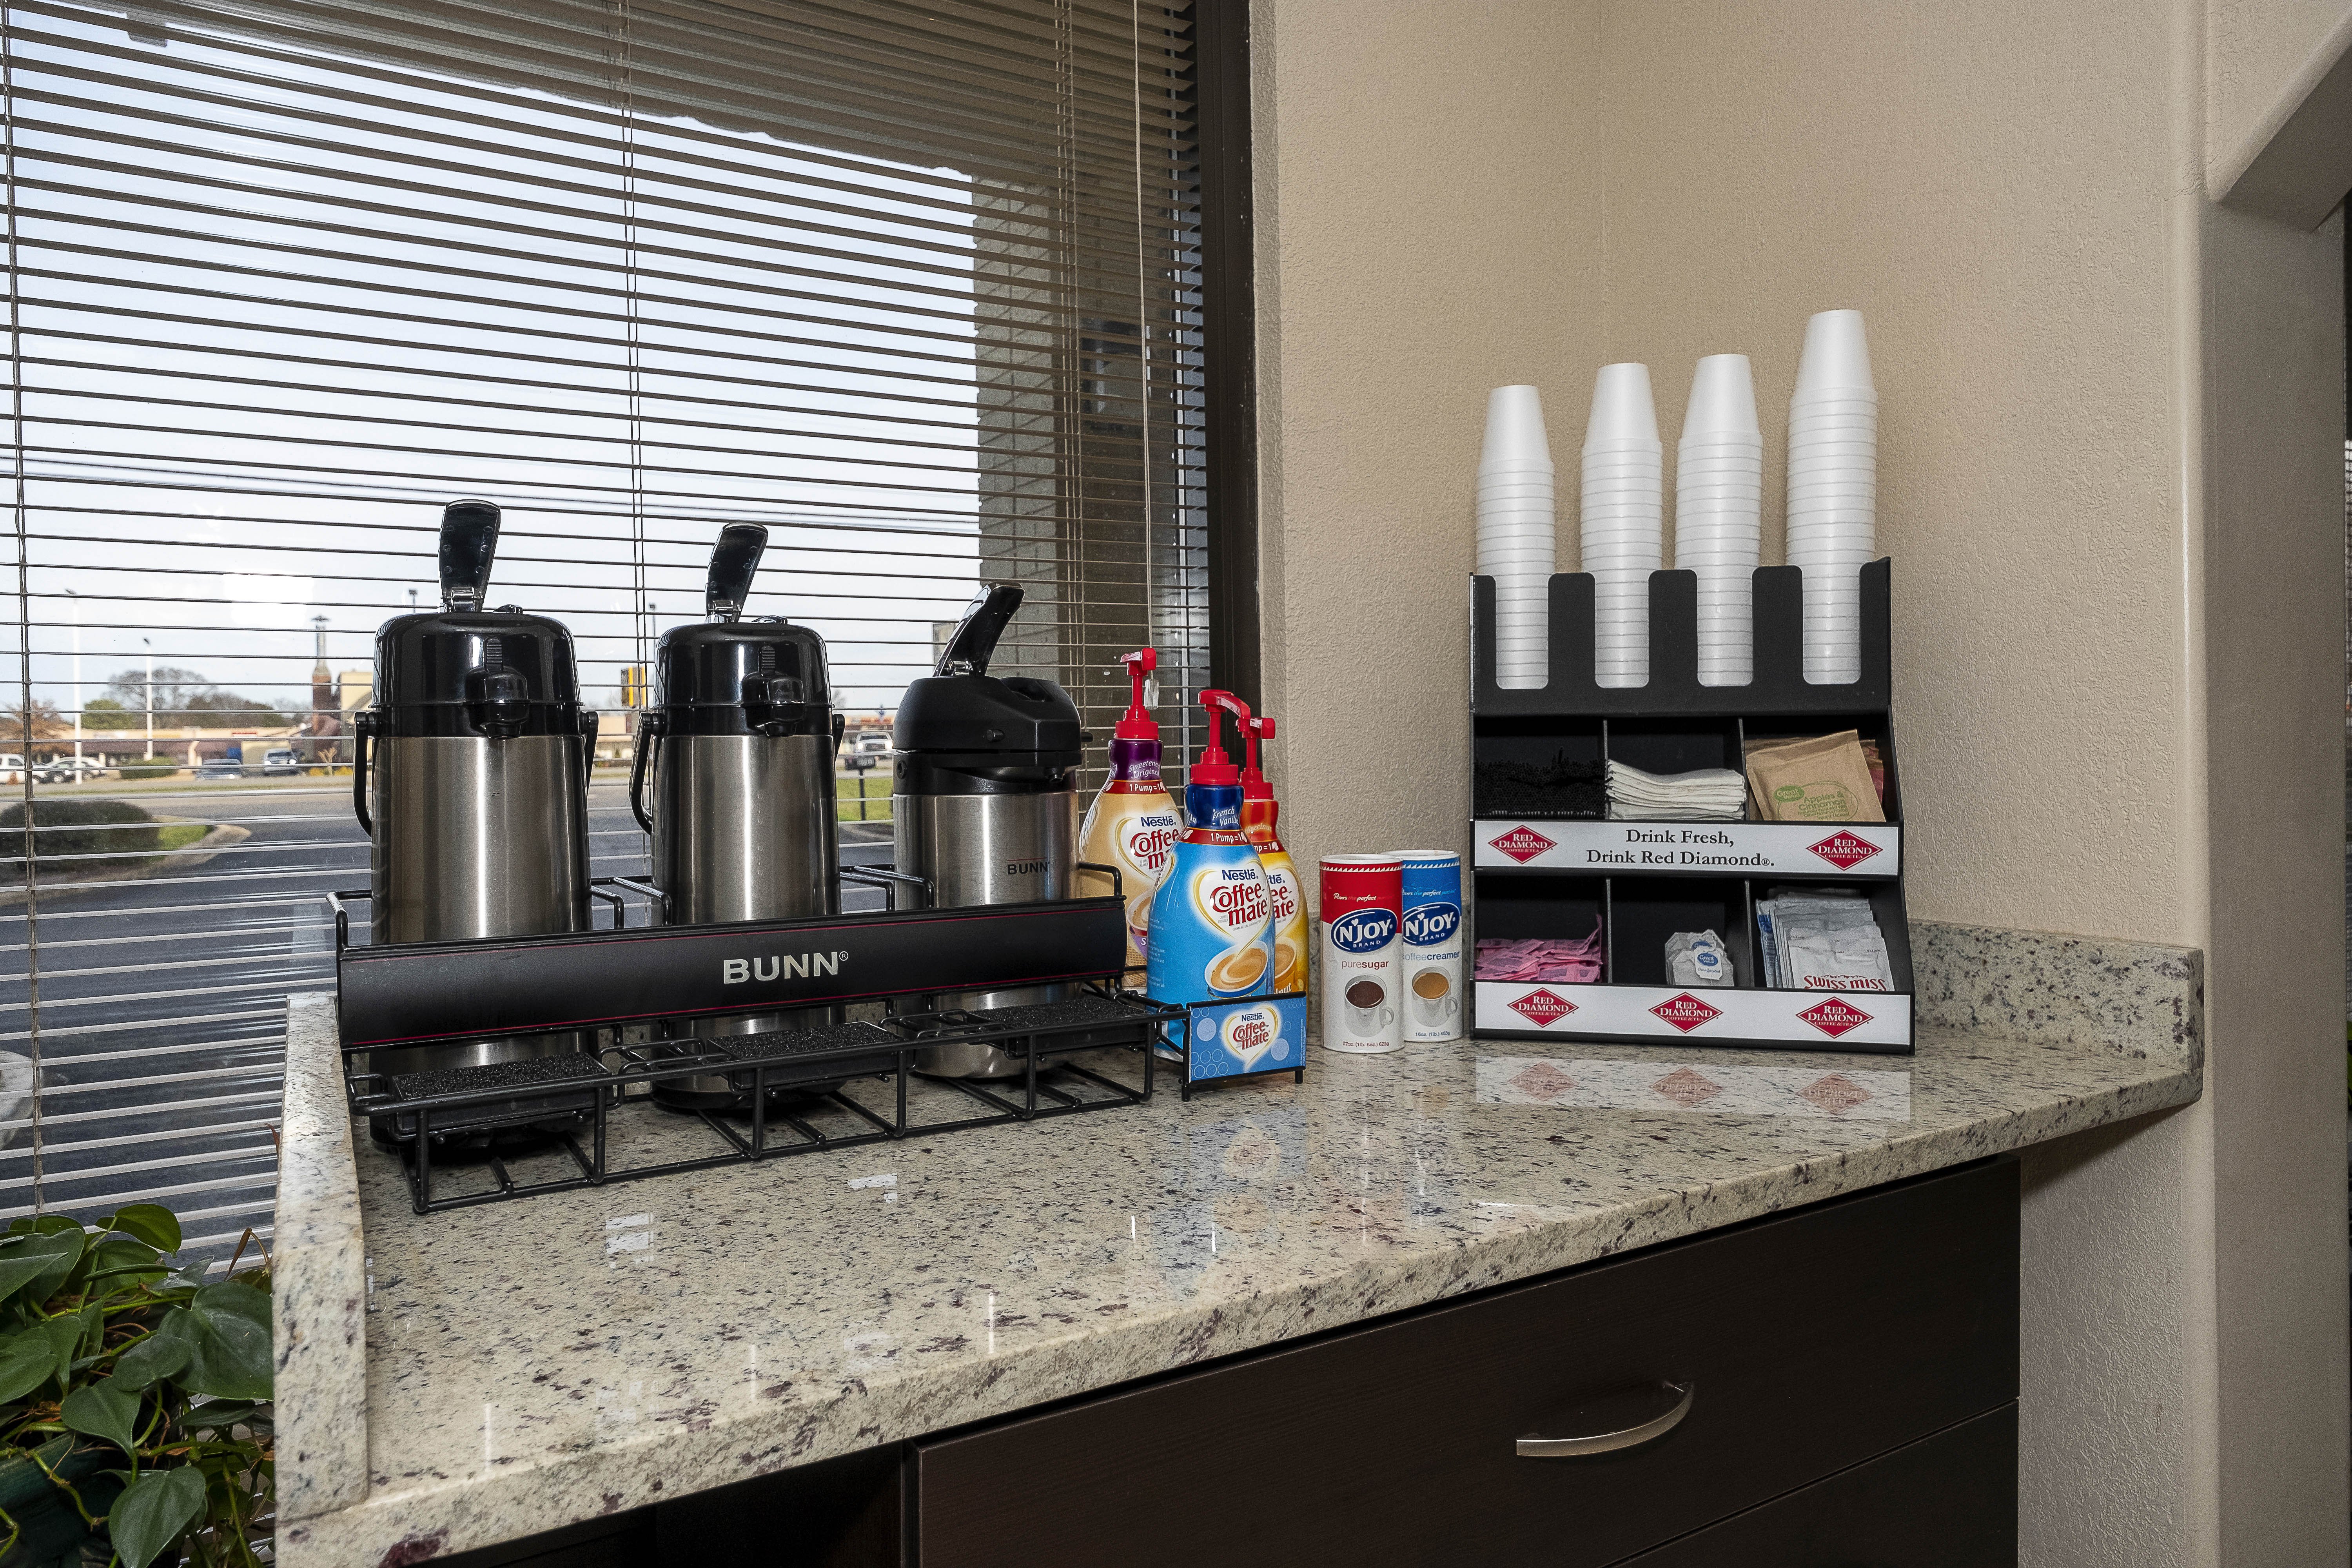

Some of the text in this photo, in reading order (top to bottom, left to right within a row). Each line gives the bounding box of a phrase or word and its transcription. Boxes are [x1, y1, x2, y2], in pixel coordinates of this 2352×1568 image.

[1135, 784, 1152, 793] Pump
[1804, 793, 1835, 804] Apples
[1213, 806, 1234, 820] French
[1141, 815, 1174, 827] Nestlé
[1220, 815, 1239, 826] Vanilla
[1216, 834, 1234, 844] Pump
[1626, 829, 1734, 847] Drink Fresh,
[1499, 840, 1548, 848] DIAMOND
[1818, 846, 1872, 854] DIAMOND
[1586, 850, 1635, 863] Drink
[1641, 851, 1674, 864] Red
[1007, 862, 1050, 875] BUNN
[1221, 869, 1259, 880] Nestlé
[1228, 899, 1268, 926] mate
[1274, 900, 1294, 919] ate
[1419, 933, 1445, 941] BRAND
[1519, 1003, 1569, 1012] DIAMOND
[1675, 1001, 1697, 1009] RED
[1824, 1005, 1846, 1014] RED
[1241, 1013, 1264, 1022] Nestlé
[1660, 1008, 1713, 1017] DIAMOND
[1808, 1013, 1863, 1022] DIAMOND
[1241, 1031, 1269, 1050] mate
